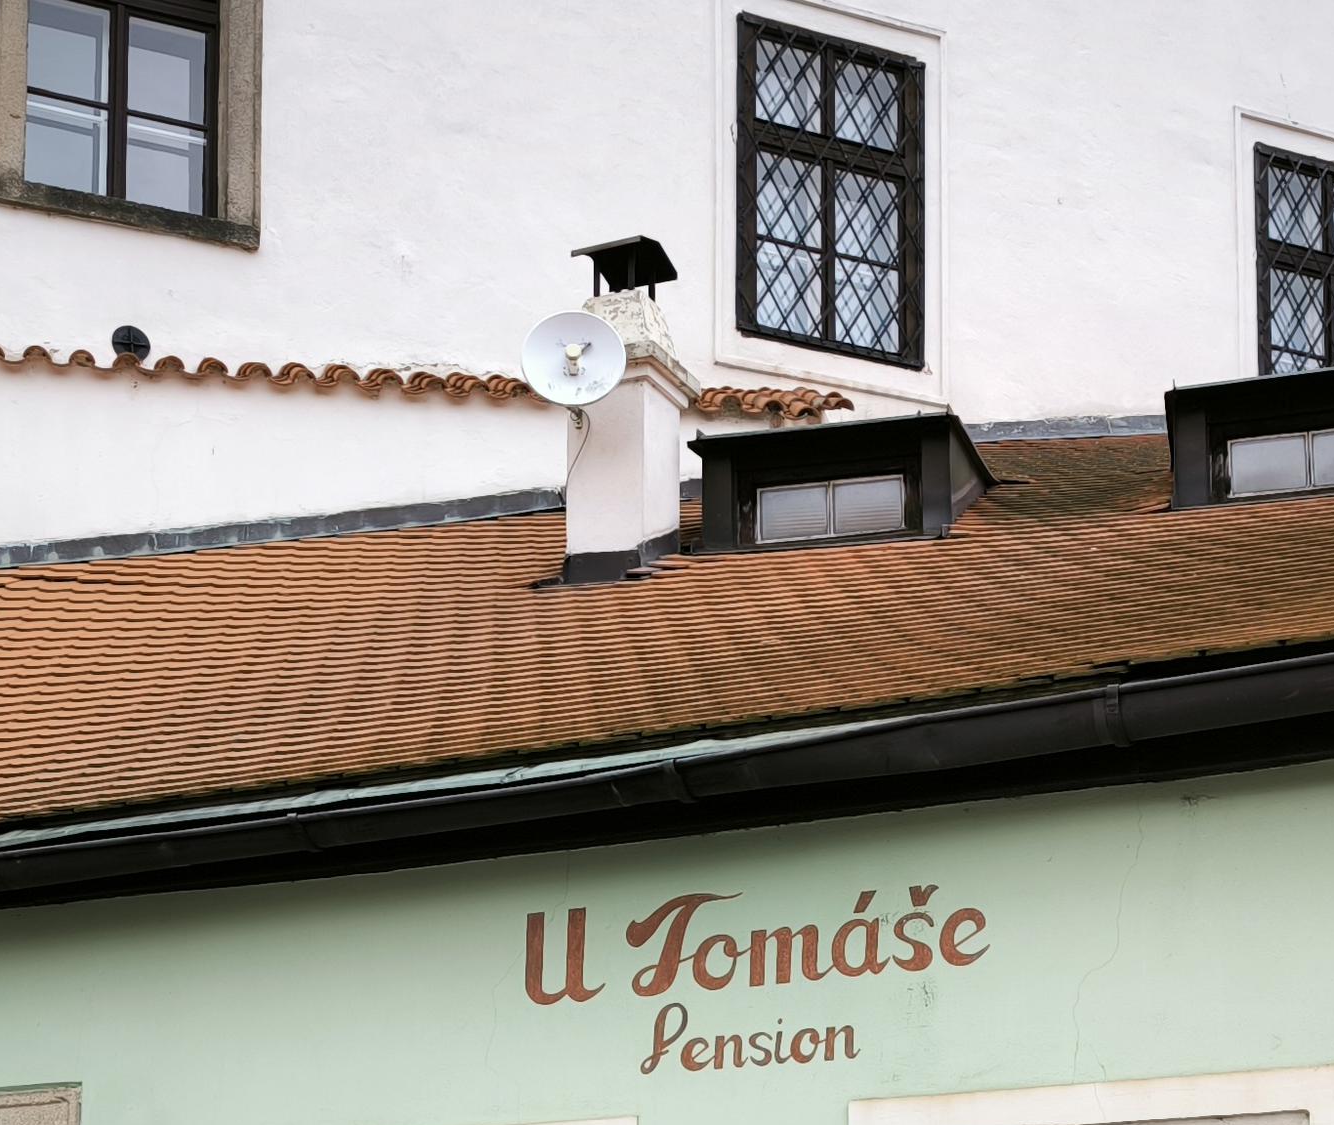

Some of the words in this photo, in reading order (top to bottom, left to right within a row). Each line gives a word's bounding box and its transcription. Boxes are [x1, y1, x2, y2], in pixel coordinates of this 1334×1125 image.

[525, 906, 606, 1006] U
[625, 884, 991, 997] Tomáše
[639, 1002, 862, 1075] Pension
